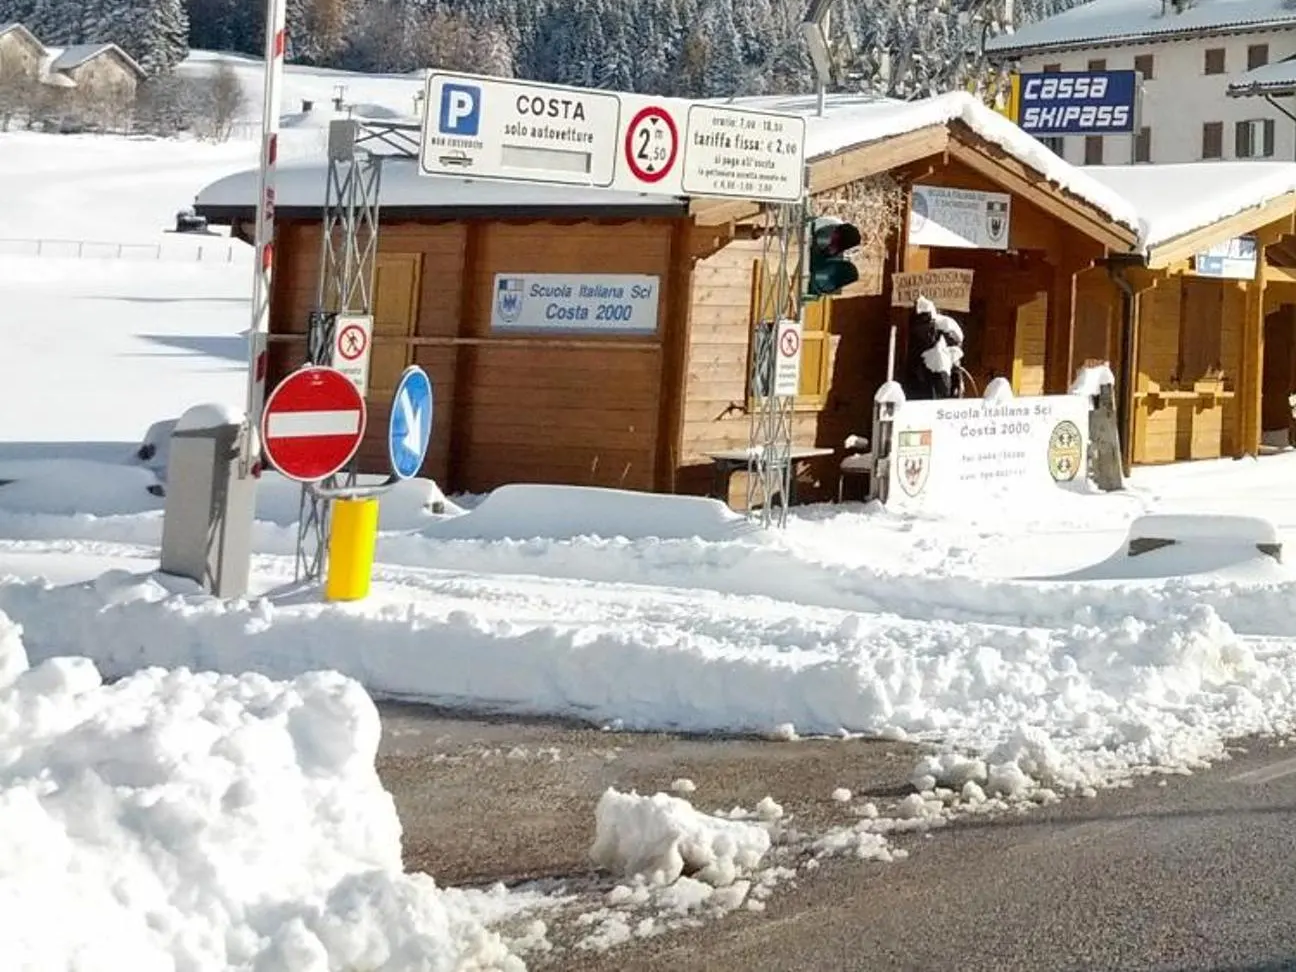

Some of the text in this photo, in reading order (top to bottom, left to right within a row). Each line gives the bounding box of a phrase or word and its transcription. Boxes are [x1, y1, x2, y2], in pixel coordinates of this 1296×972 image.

[448, 90, 474, 128] P
[515, 94, 585, 121] COSTA
[504, 122, 594, 144] solo autovetture
[694, 132, 731, 149] tariffa
[530, 283, 653, 300] Scuola Italiana Sci
[545, 303, 633, 322] Costa 2000
[936, 407, 981, 420] Scuola
[1034, 404, 1053, 416] Sci
[960, 422, 1031, 437] Costa 2000
